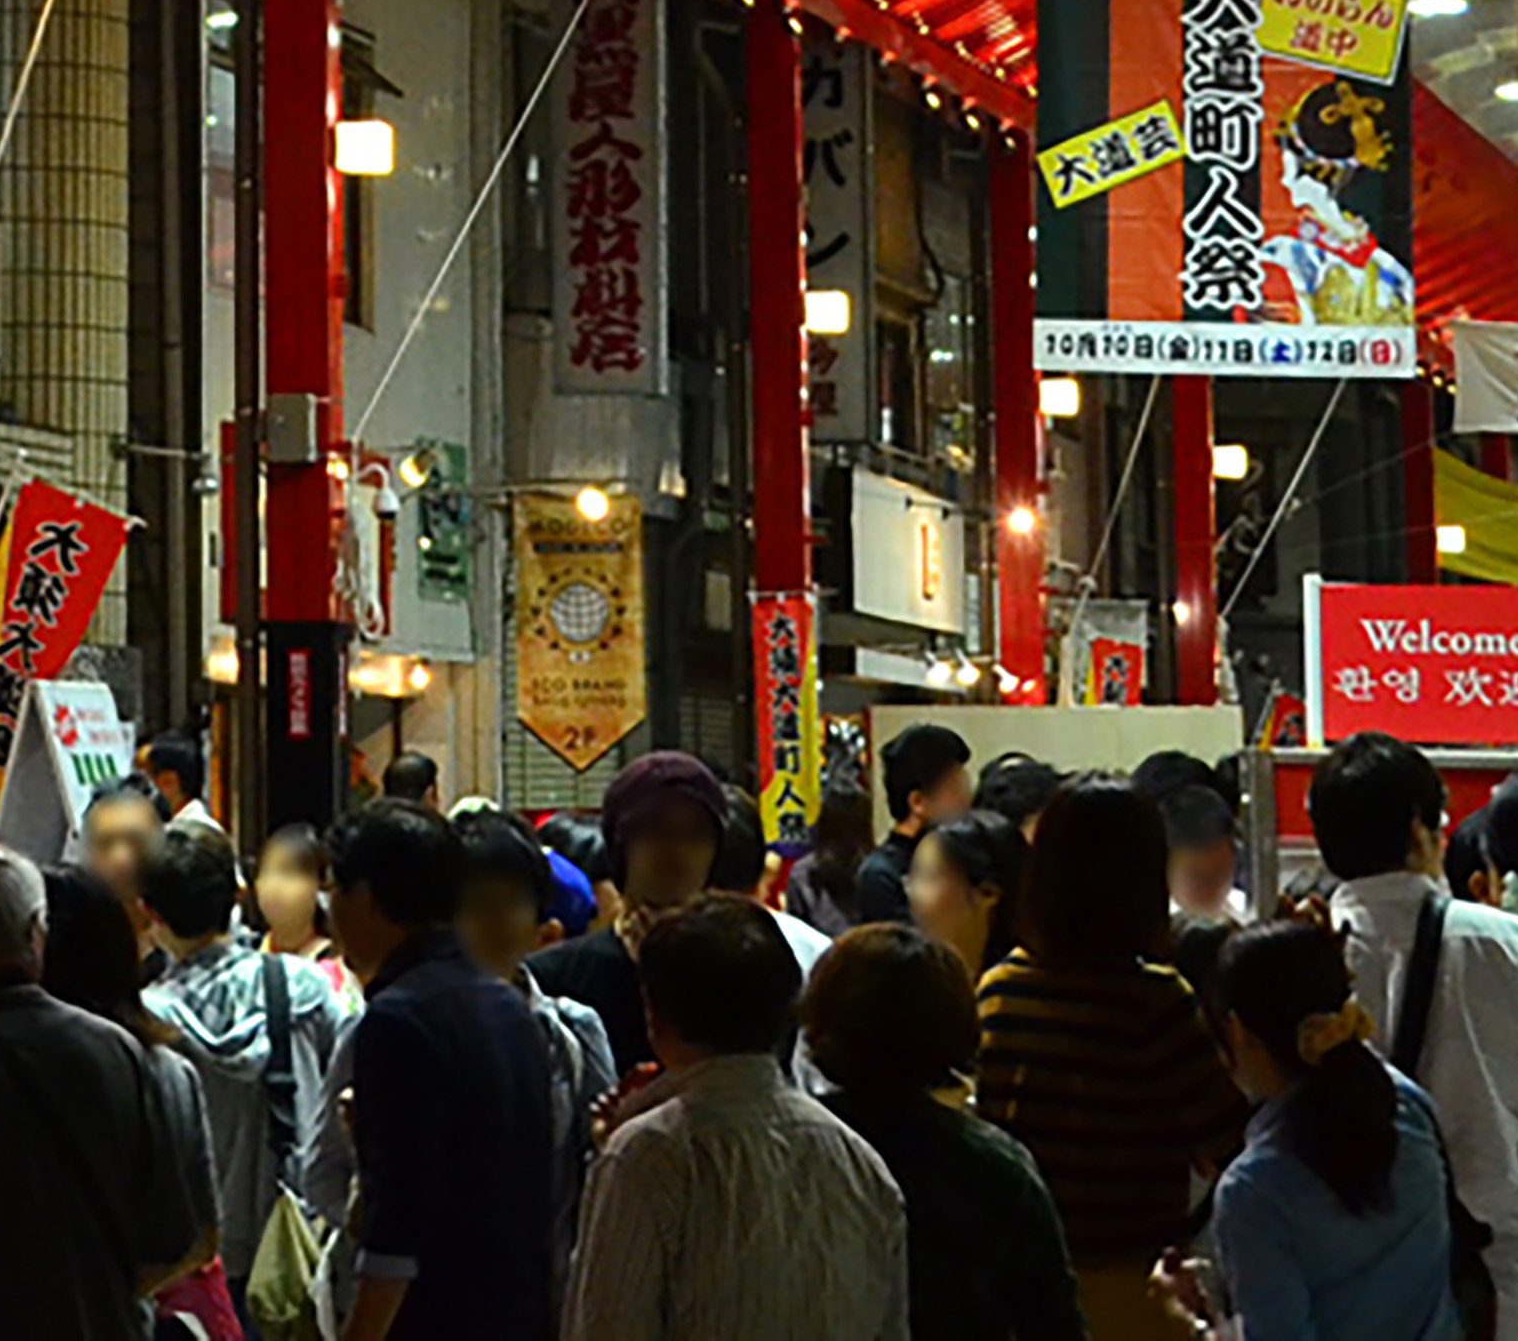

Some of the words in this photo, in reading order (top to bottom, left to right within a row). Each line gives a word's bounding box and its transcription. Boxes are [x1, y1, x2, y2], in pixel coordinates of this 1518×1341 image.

[1288, 19, 1361, 59] 道中
[1051, 113, 1182, 199] 大道芸
